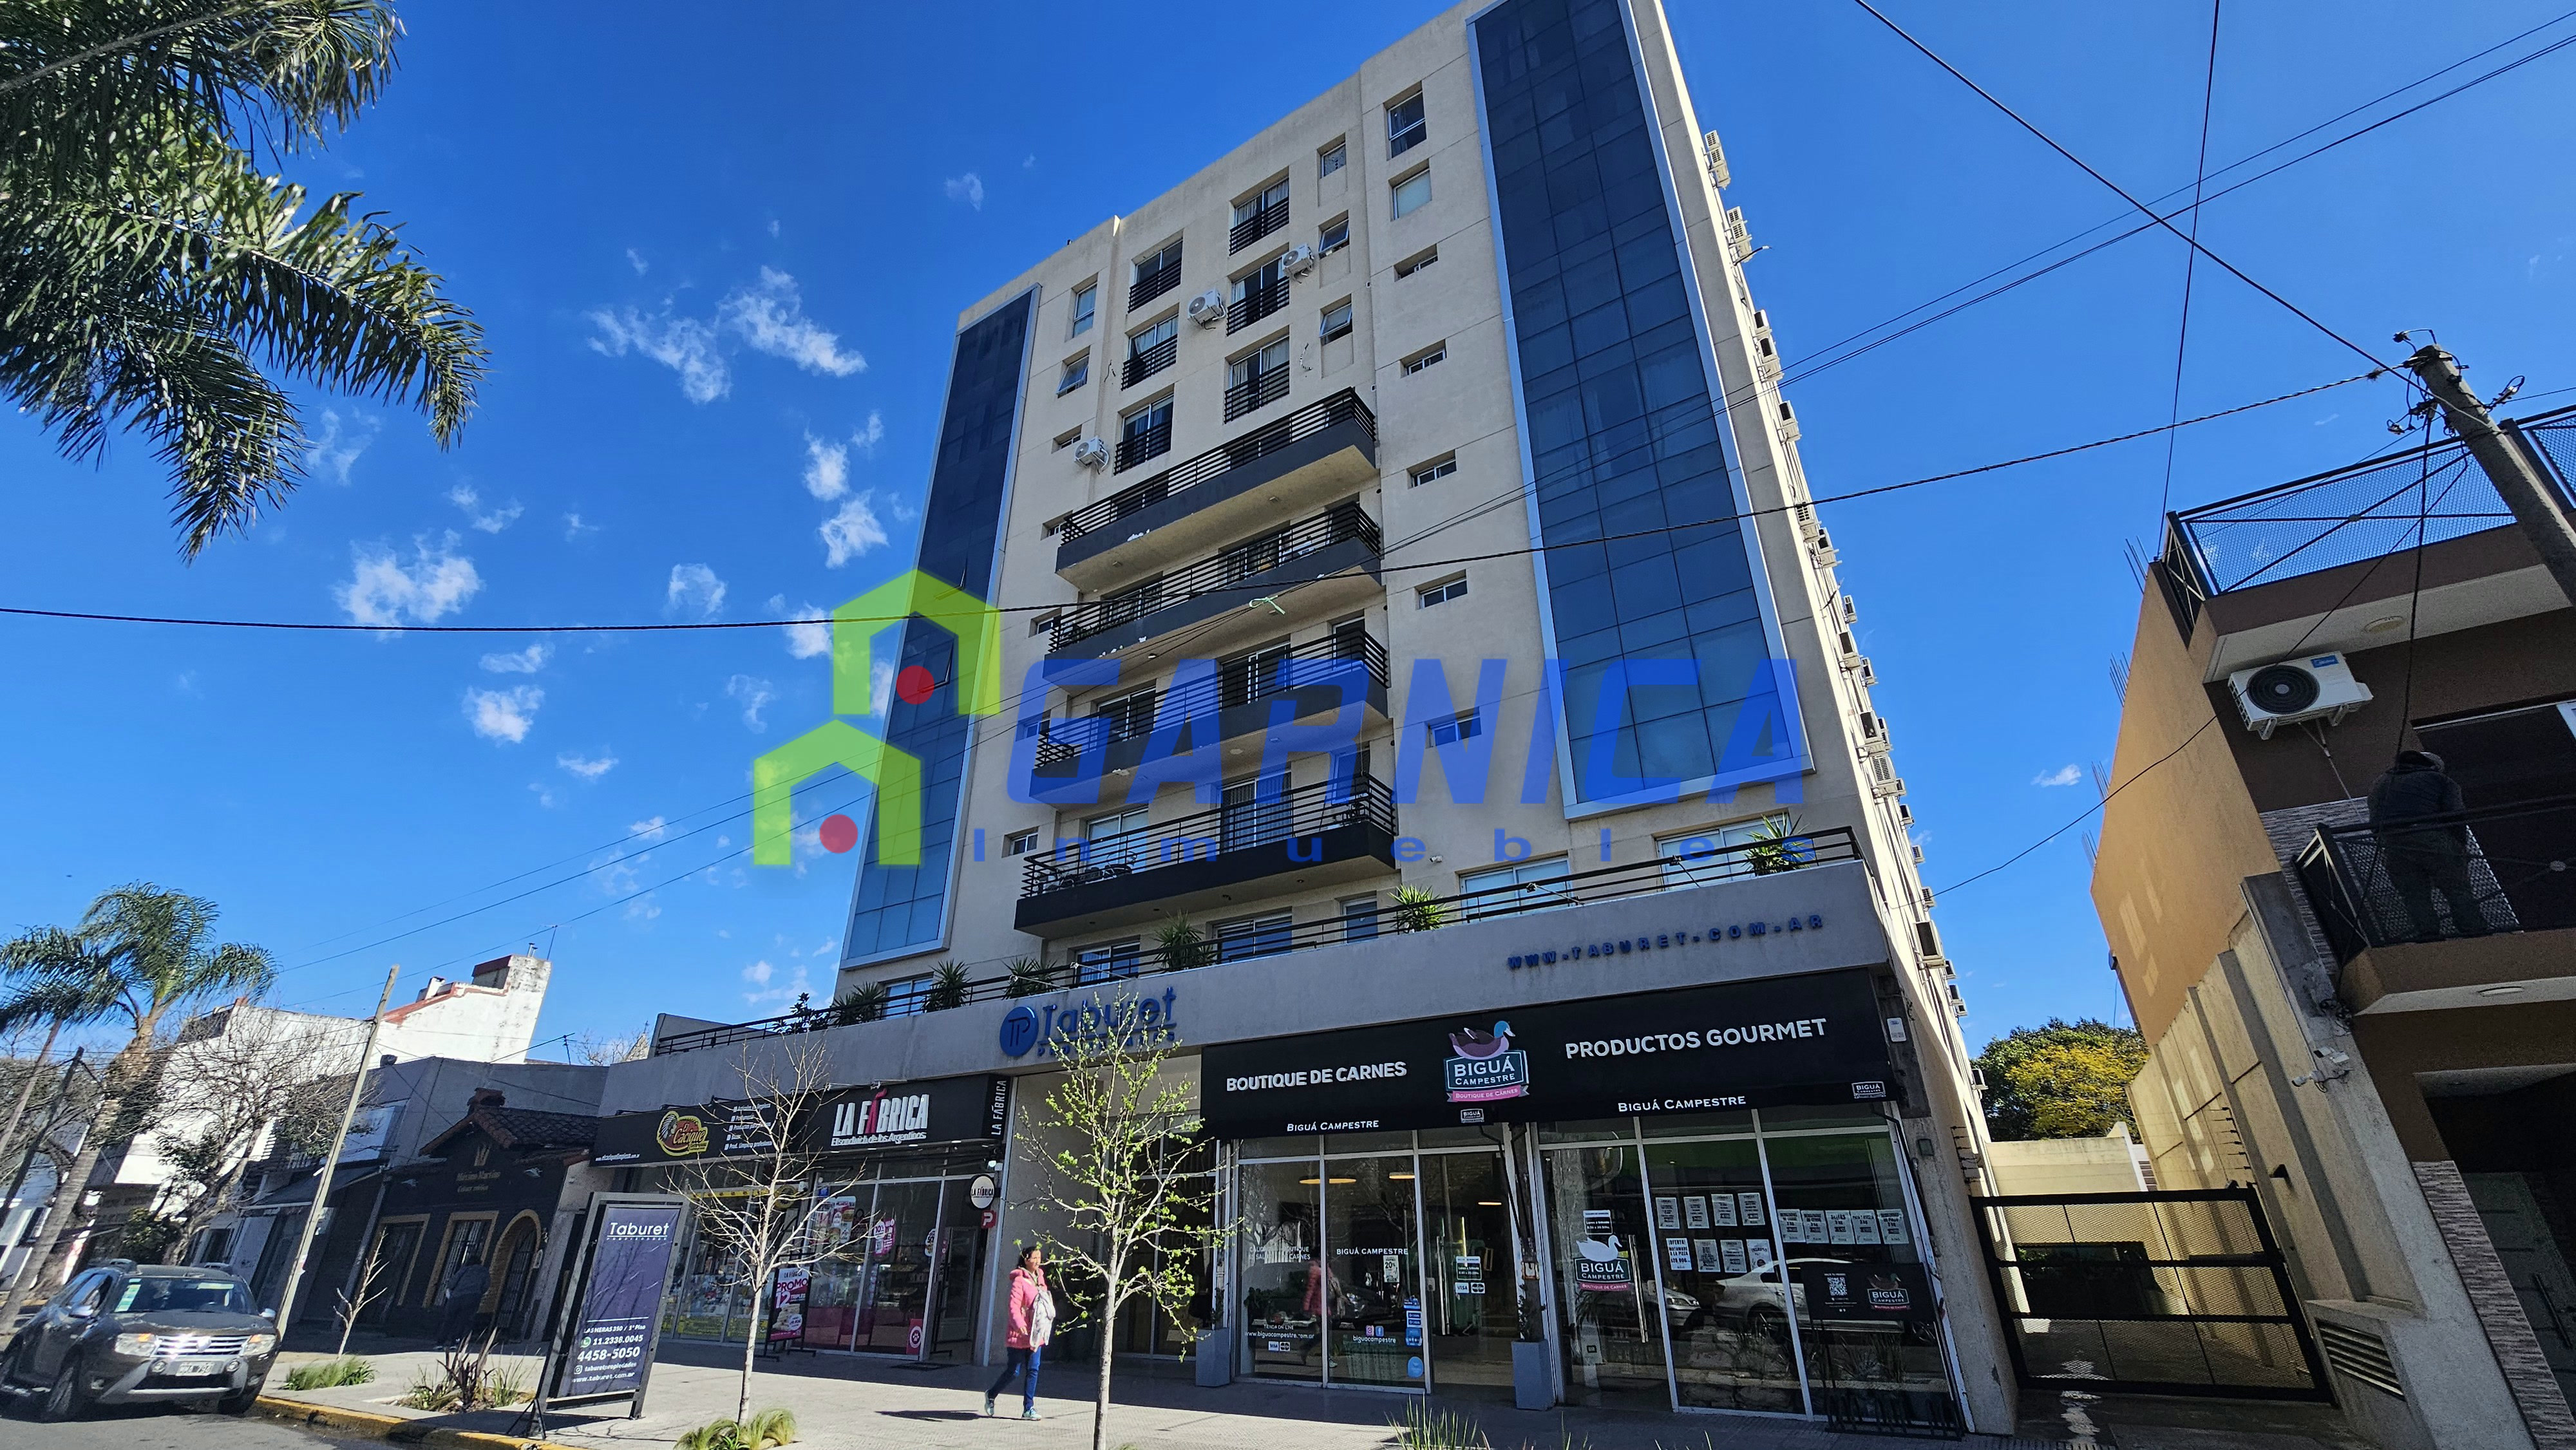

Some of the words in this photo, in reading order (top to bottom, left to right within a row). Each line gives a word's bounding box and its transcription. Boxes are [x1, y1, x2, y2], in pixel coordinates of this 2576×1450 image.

[1508, 914, 1823, 969] WWW.TABURET.COM.AR
[1043, 986, 1177, 1037] Taburet
[1566, 1031, 1701, 1059] PRODUCTOS
[1706, 1018, 1827, 1046] GOURMET
[1454, 1055, 1515, 1077] BIGUÁ
[1226, 1071, 1307, 1091] BOUTIQUE
[1310, 1069, 1333, 1084] DE
[1336, 1061, 1407, 1082] CARNES
[1455, 1073, 1515, 1085] CAMPESTRE
[992, 1080, 1007, 1120] FÁBRICA
[1495, 1088, 1518, 1097] CARNES
[1618, 1098, 1660, 1112] BIGUÁ
[1664, 1096, 1747, 1109] CAMPESTRE
[833, 1102, 856, 1137] LA
[857, 1088, 930, 1135] FÁBRICA
[991, 1124, 1002, 1135] LA
[1287, 1121, 1317, 1132] BIGUÁ
[1320, 1120, 1379, 1130] CAMPESTRE
[673, 1128, 705, 1150] Cacique
[610, 1222, 670, 1235] Taburet
[1336, 1247, 1359, 1255] BIGUÁ
[1580, 1261, 1625, 1274] BIGUÁ
[777, 1277, 808, 1292] PROMO
[775, 1290, 791, 1309] 12
[1872, 1290, 1904, 1299] BIGUÁ
[592, 1335, 643, 1346] 11.2338.0045
[577, 1346, 641, 1362] 4458-5050
[572, 1372, 635, 1383] www.taburet.com.ar
